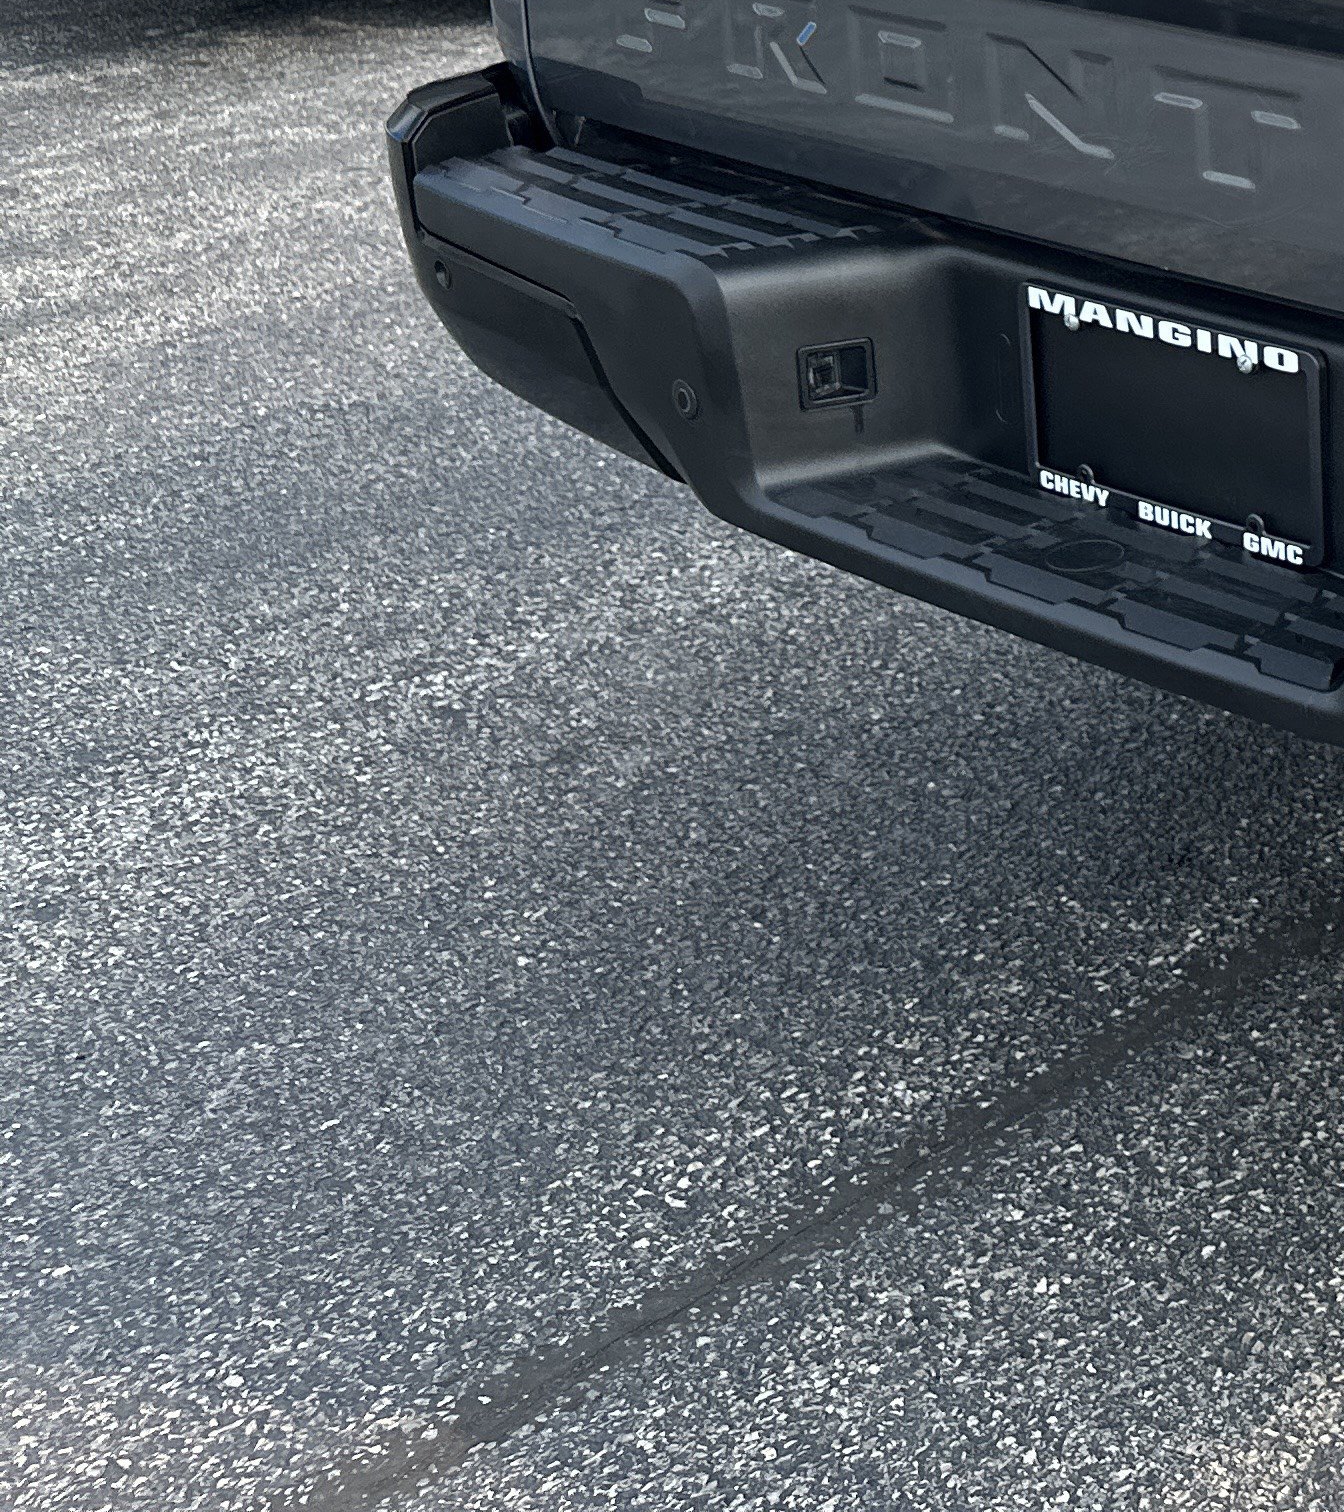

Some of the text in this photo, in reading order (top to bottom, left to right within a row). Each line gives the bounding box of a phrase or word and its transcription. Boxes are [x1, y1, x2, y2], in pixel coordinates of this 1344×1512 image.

[1027, 286, 1299, 374] MANGINO
[1040, 470, 1304, 566] CHEVY BUICK GMC
